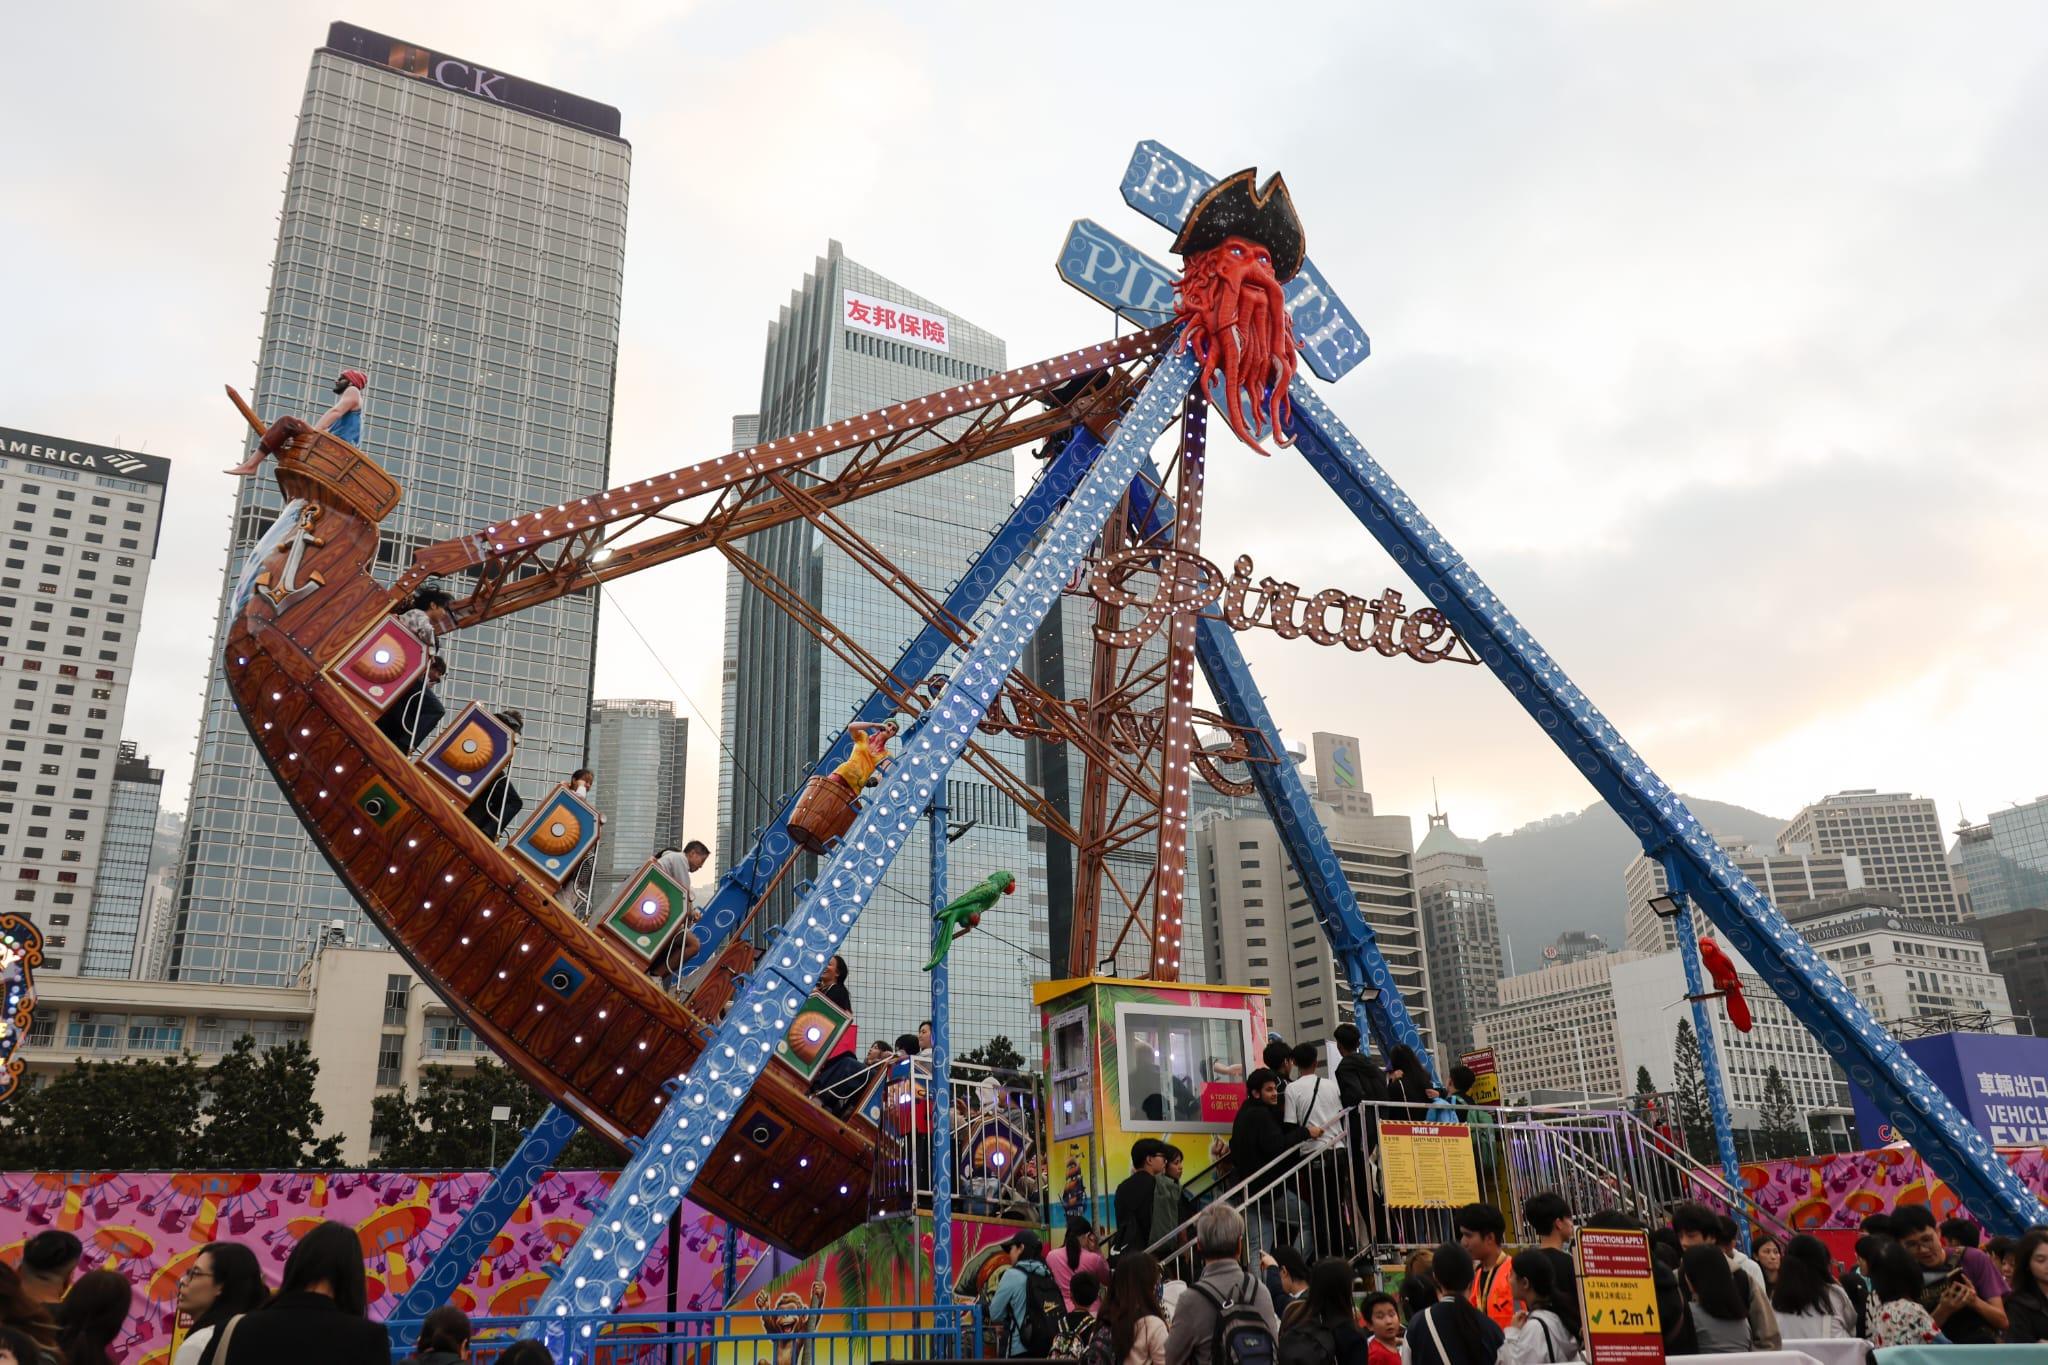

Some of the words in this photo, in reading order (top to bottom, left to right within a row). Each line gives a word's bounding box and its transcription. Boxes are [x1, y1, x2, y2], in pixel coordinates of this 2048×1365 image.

[435, 60, 506, 103] CK
[847, 299, 946, 345] 友邦保險
[0, 438, 97, 468] AMERICA
[1088, 546, 1457, 664] Pirate
[1818, 921, 1866, 940] ORIENTAL
[1902, 921, 1940, 935] MANDARIN
[1940, 927, 1976, 940] ORIENTAL
[1977, 1072, 2048, 1098] 車輛出口
[1582, 1234, 1624, 1245] RESTRICTIONS
[1625, 1236, 1644, 1245] APPLY
[1609, 1309, 1644, 1326] 1.2m
